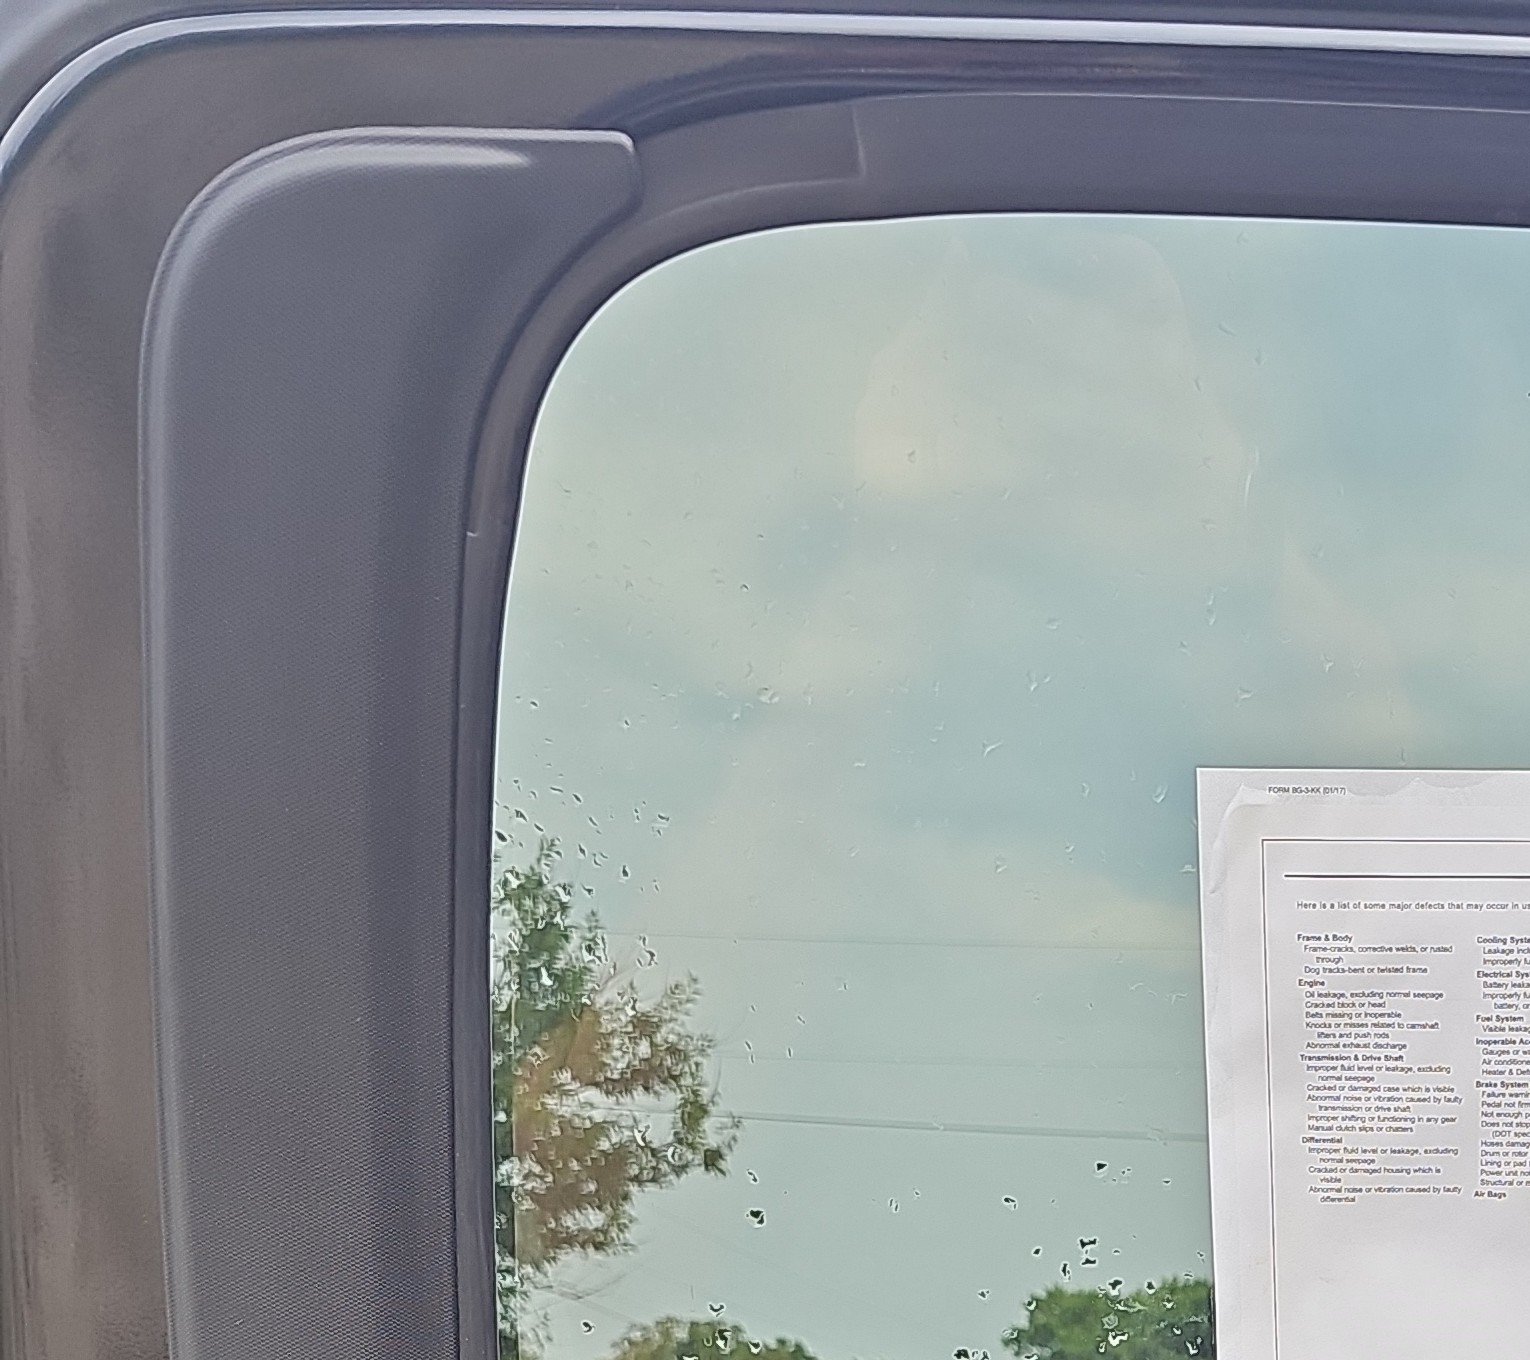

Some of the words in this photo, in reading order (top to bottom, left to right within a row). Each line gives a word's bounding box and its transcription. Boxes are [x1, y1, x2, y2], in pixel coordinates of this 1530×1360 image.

[1268, 786, 1290, 795] FORM
[1297, 901, 1316, 910] Here
[1319, 901, 1326, 910] is
[1337, 901, 1349, 910] list
[1352, 901, 1360, 910] of
[1388, 903, 1411, 912] major
[1414, 902, 1444, 910] defects
[1447, 902, 1463, 910] that
[1466, 903, 1483, 912] may
[1511, 902, 1518, 910] in
[1297, 934, 1321, 942] Frame
[1324, 934, 1330, 942] &
[1332, 934, 1352, 943] Body
[1476, 936, 1507, 945] Cooling
[1483, 946, 1514, 955] Leakage
[1304, 966, 1320, 975] Dog
[1406, 966, 1427, 974] frame
[1476, 970, 1512, 978] Electrical
[1298, 979, 1325, 988] Engine
[1482, 981, 1508, 990] Battery
[1495, 1015, 1524, 1023] System
[1305, 1041, 1340, 1049] Abnormal
[1372, 1042, 1407, 1051] discharge
[1476, 1038, 1516, 1046] Inoperable
[1300, 1054, 1351, 1062] Transmission
[1353, 1054, 1359, 1062] &
[1361, 1054, 1381, 1062] Drive
[1384, 1054, 1403, 1062] Shaft
[1475, 1080, 1497, 1088] Brake
[1500, 1080, 1528, 1089] System
[1481, 1100, 1502, 1108] Pedal
[1503, 1100, 1515, 1108] not
[1517, 1100, 1530, 1108] firm
[1301, 1136, 1342, 1144] Differential
[1474, 1190, 1485, 1198] Air
[1487, 1190, 1506, 1199] Bags
